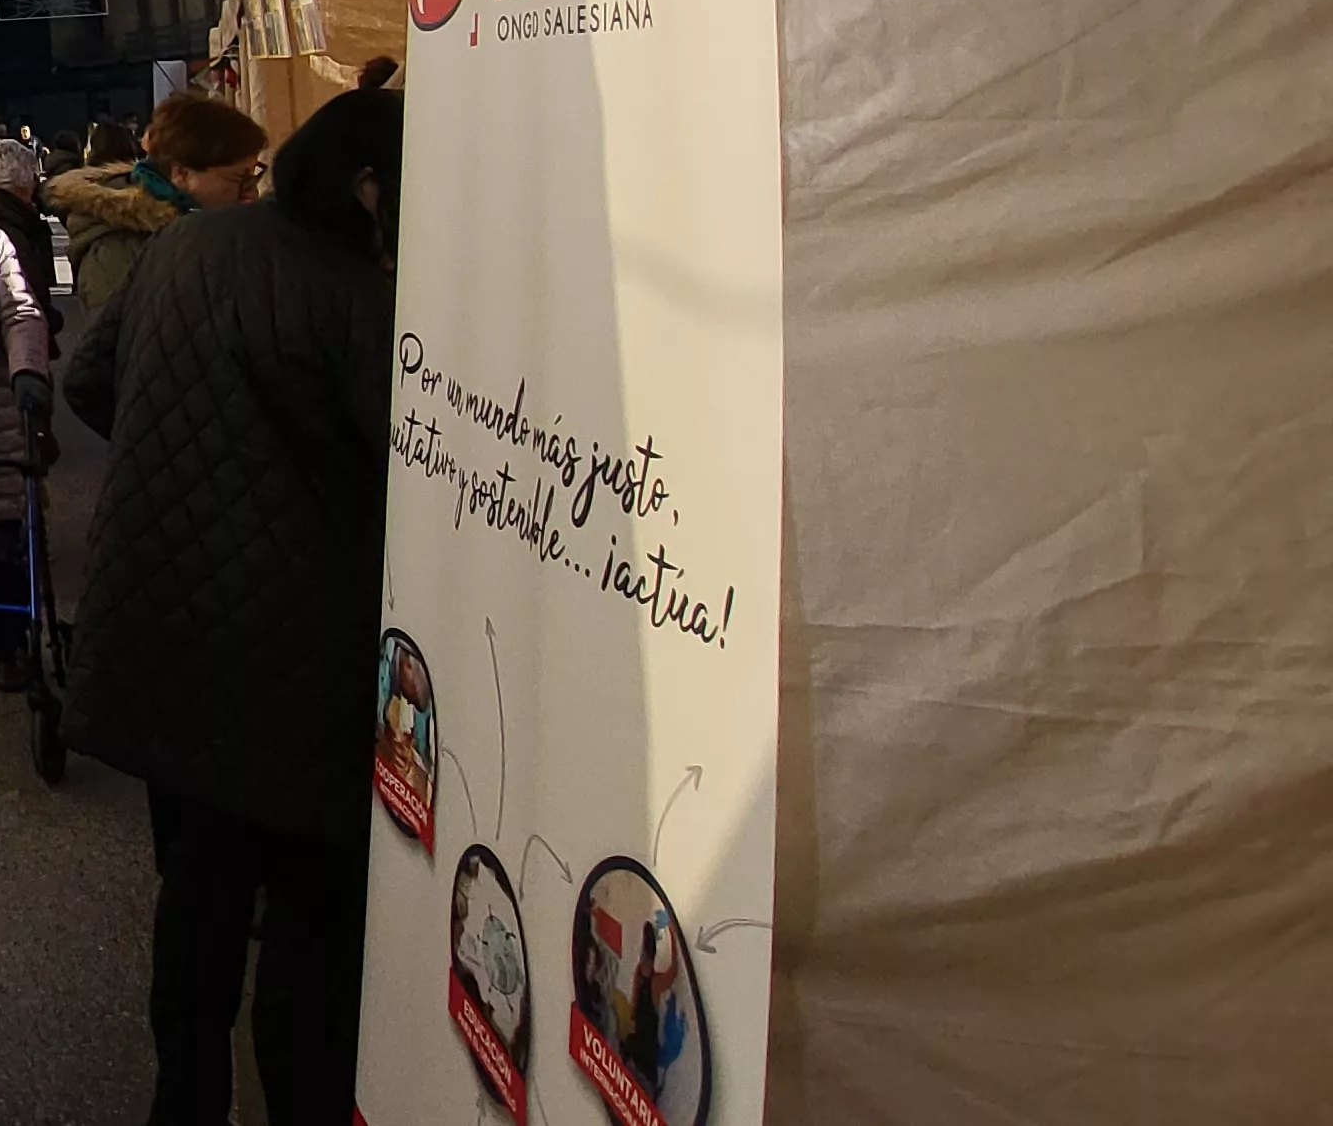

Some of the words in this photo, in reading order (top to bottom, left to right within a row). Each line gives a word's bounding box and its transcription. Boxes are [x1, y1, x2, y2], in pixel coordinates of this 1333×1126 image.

[497, 11, 539, 42] ONGD
[399, 333, 442, 395] Por
[466, 377, 530, 446] mundo
[533, 414, 582, 487] más
[572, 435, 679, 529] justo,
[455, 467, 468, 531] y
